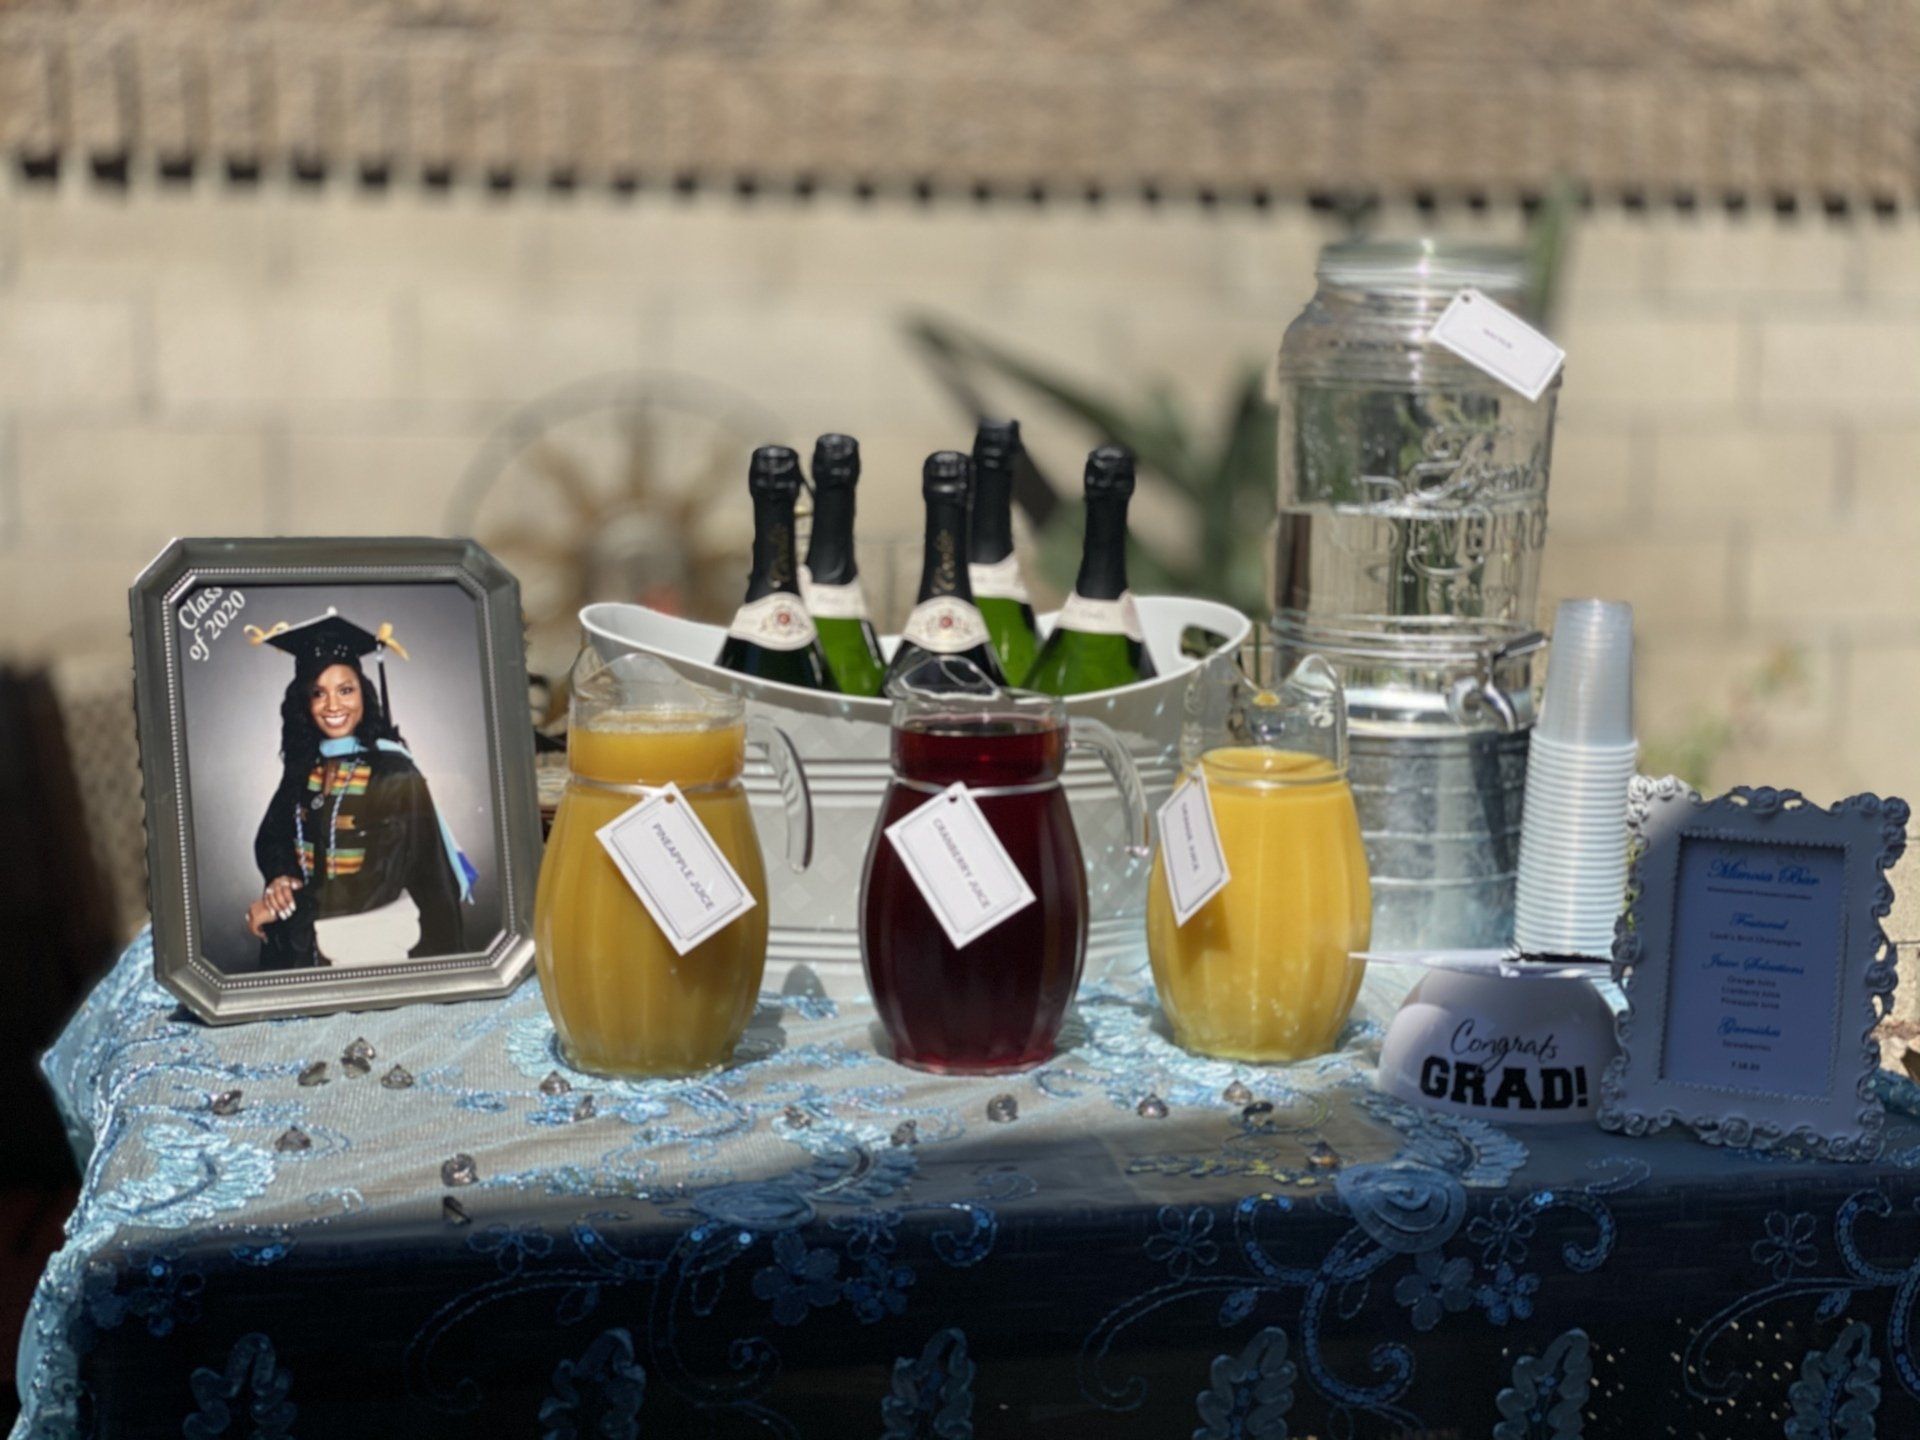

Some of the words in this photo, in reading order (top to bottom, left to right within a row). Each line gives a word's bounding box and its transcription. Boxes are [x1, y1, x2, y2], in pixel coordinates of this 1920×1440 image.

[178, 587, 222, 630] Class
[190, 628, 209, 661] of
[205, 590, 245, 640] 2020
[652, 822, 694, 880] PINEAPPLE
[690, 880, 715, 910] JUICE
[1450, 1018, 1559, 1075] Congrats
[1419, 1055, 1588, 1110] GRAD!
